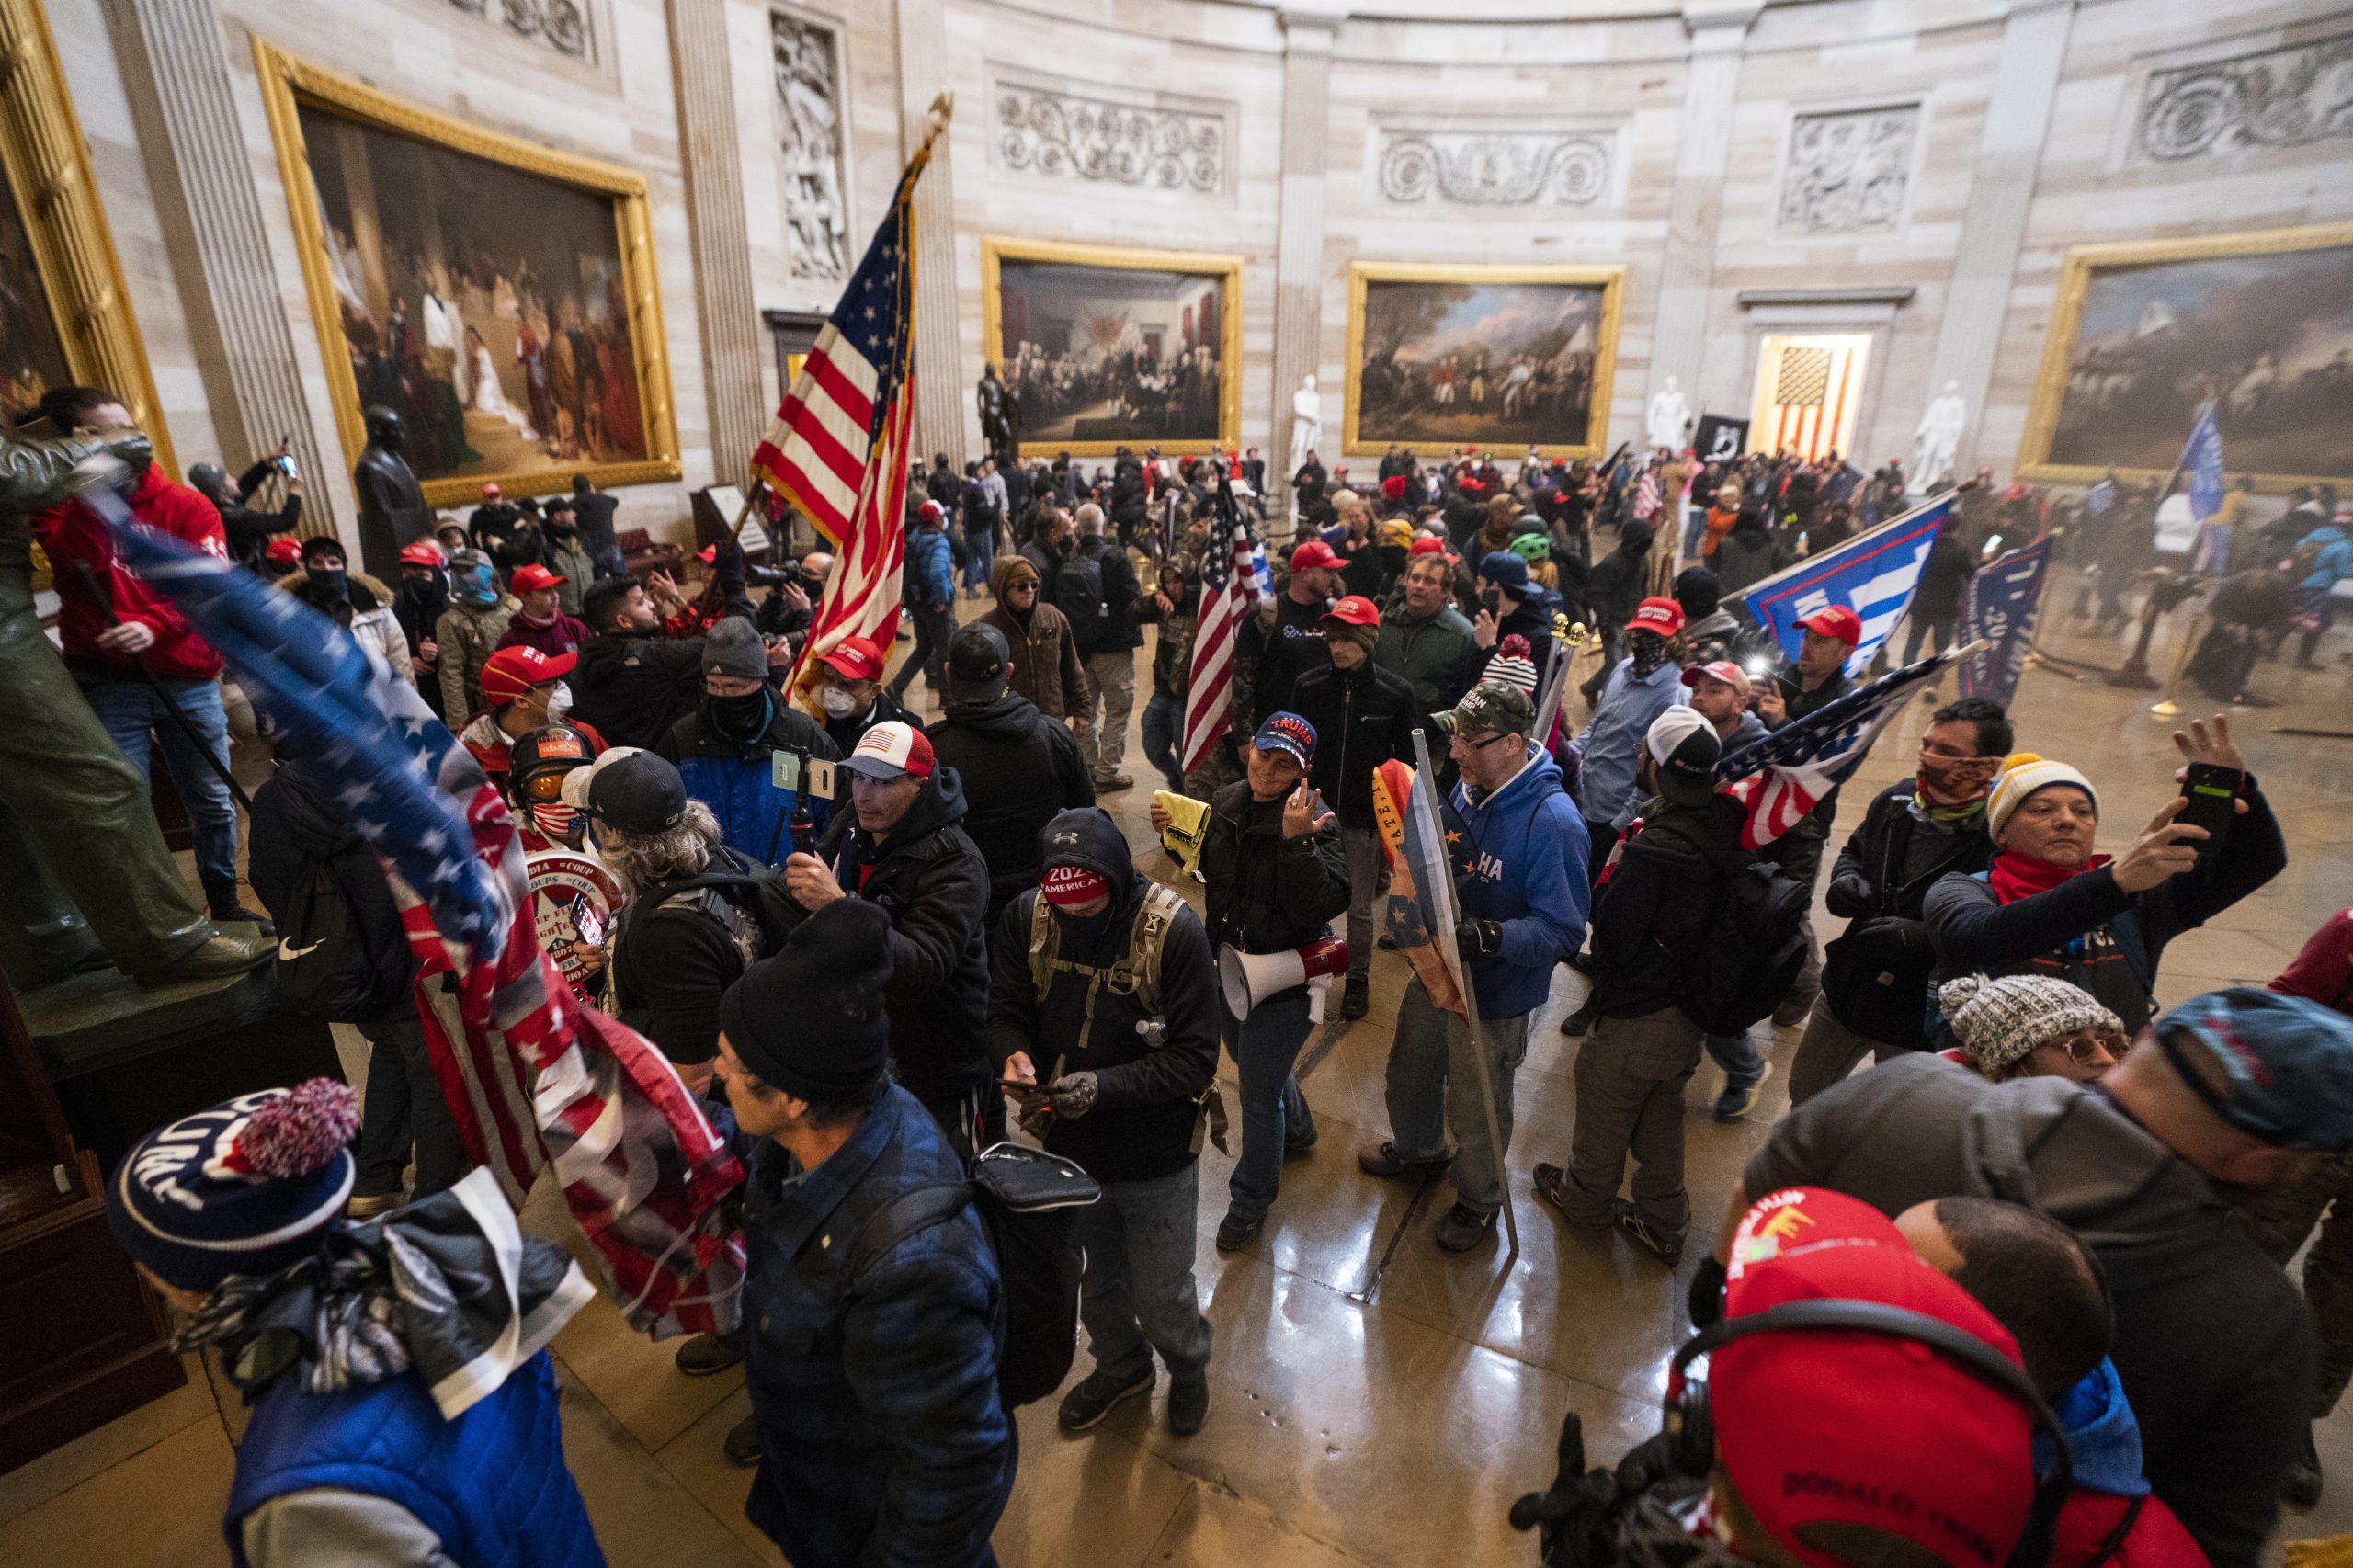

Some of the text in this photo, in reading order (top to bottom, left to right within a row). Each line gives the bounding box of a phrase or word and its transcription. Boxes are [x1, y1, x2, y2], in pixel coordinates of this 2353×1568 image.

[1271, 719, 1313, 745] TRUMP
[530, 875, 560, 891] OUPS
[1044, 878, 1098, 893] AMERICA
